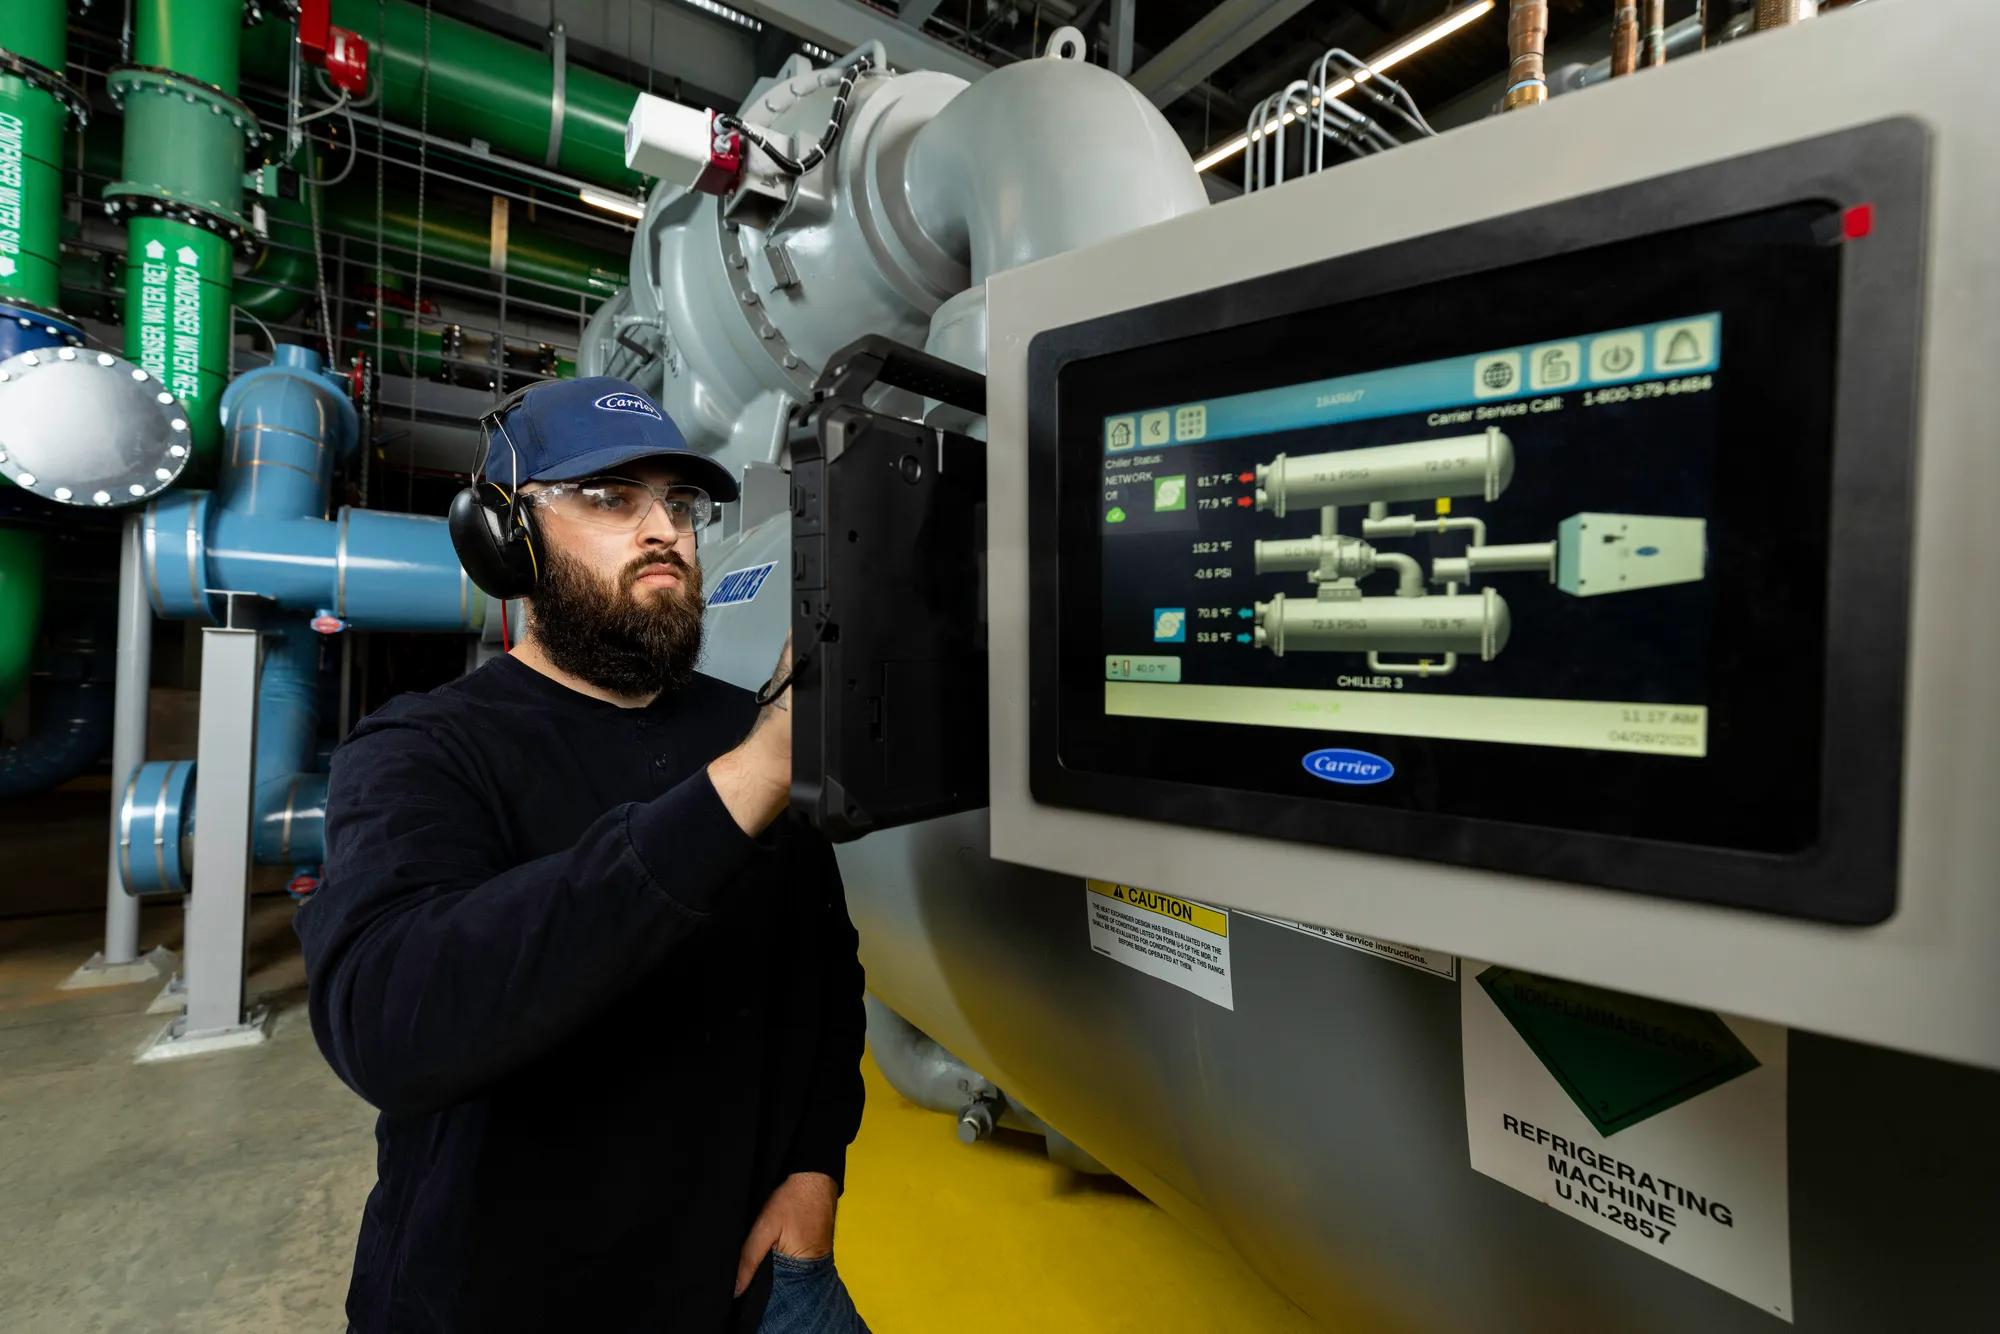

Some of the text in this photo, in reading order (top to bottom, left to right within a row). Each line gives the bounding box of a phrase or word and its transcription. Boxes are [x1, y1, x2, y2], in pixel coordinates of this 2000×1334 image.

[0, 186, 21, 230] WATER
[142, 286, 166, 323] WATER
[173, 266, 200, 336] CONDENSER
[141, 325, 166, 385] NDENSER
[173, 335, 199, 374] WATER
[606, 397, 655, 413] Carrier
[1427, 410, 1472, 427] Carrier
[1475, 403, 1528, 421] Service
[1530, 396, 1564, 414] Call:
[1105, 454, 1163, 470] Chiller Status:
[1105, 471, 1153, 486] NETWORK
[1105, 491, 1118, 501] Off
[1198, 498, 1219, 510] 77.9
[1192, 542, 1219, 554] 152.2
[707, 564, 773, 605] CHILLER 3
[1214, 568, 1232, 578] PSI
[1337, 675, 1404, 690] CHILLER 3
[1314, 756, 1382, 777] Carrier
[1128, 888, 1192, 921] CAUTION
[1110, 910, 1134, 923] EXCHANGER
[1135, 918, 1151, 928] DESIGN
[1152, 924, 1161, 932] HAS
[1162, 926, 1174, 936] BEEN
[1175, 931, 1200, 947] EVALUATED
[1201, 942, 1211, 951] FOR
[1211, 946, 1222, 955] THE
[1115, 919, 1139, 933] CONDITIONS
[1140, 929, 1154, 939] LISTED
[1163, 936, 1175, 946] FORM
[1191, 947, 1200, 956] THE
[1118, 937, 1134, 949] BEFORE
[1134, 943, 1147, 954] BEING
[1148, 949, 1172, 962] OPERATED
[1330, 929, 1344, 939] See
[1345, 934, 1374, 948] service
[1375, 942, 1428, 964] instructions.
[1110, 926, 1139, 942] RE-EVALUATED
[1149, 940, 1176, 956] CONDITIONS
[1177, 951, 1196, 964] OUTSIDE
[1196, 959, 1207, 968] THIS
[1208, 963, 1225, 976] RANGE
[1502, 1112, 1734, 1228] REFRIGERATING
[1547, 1153, 1677, 1227] MACHINE
[1555, 1178, 1672, 1245] U.N.2857
